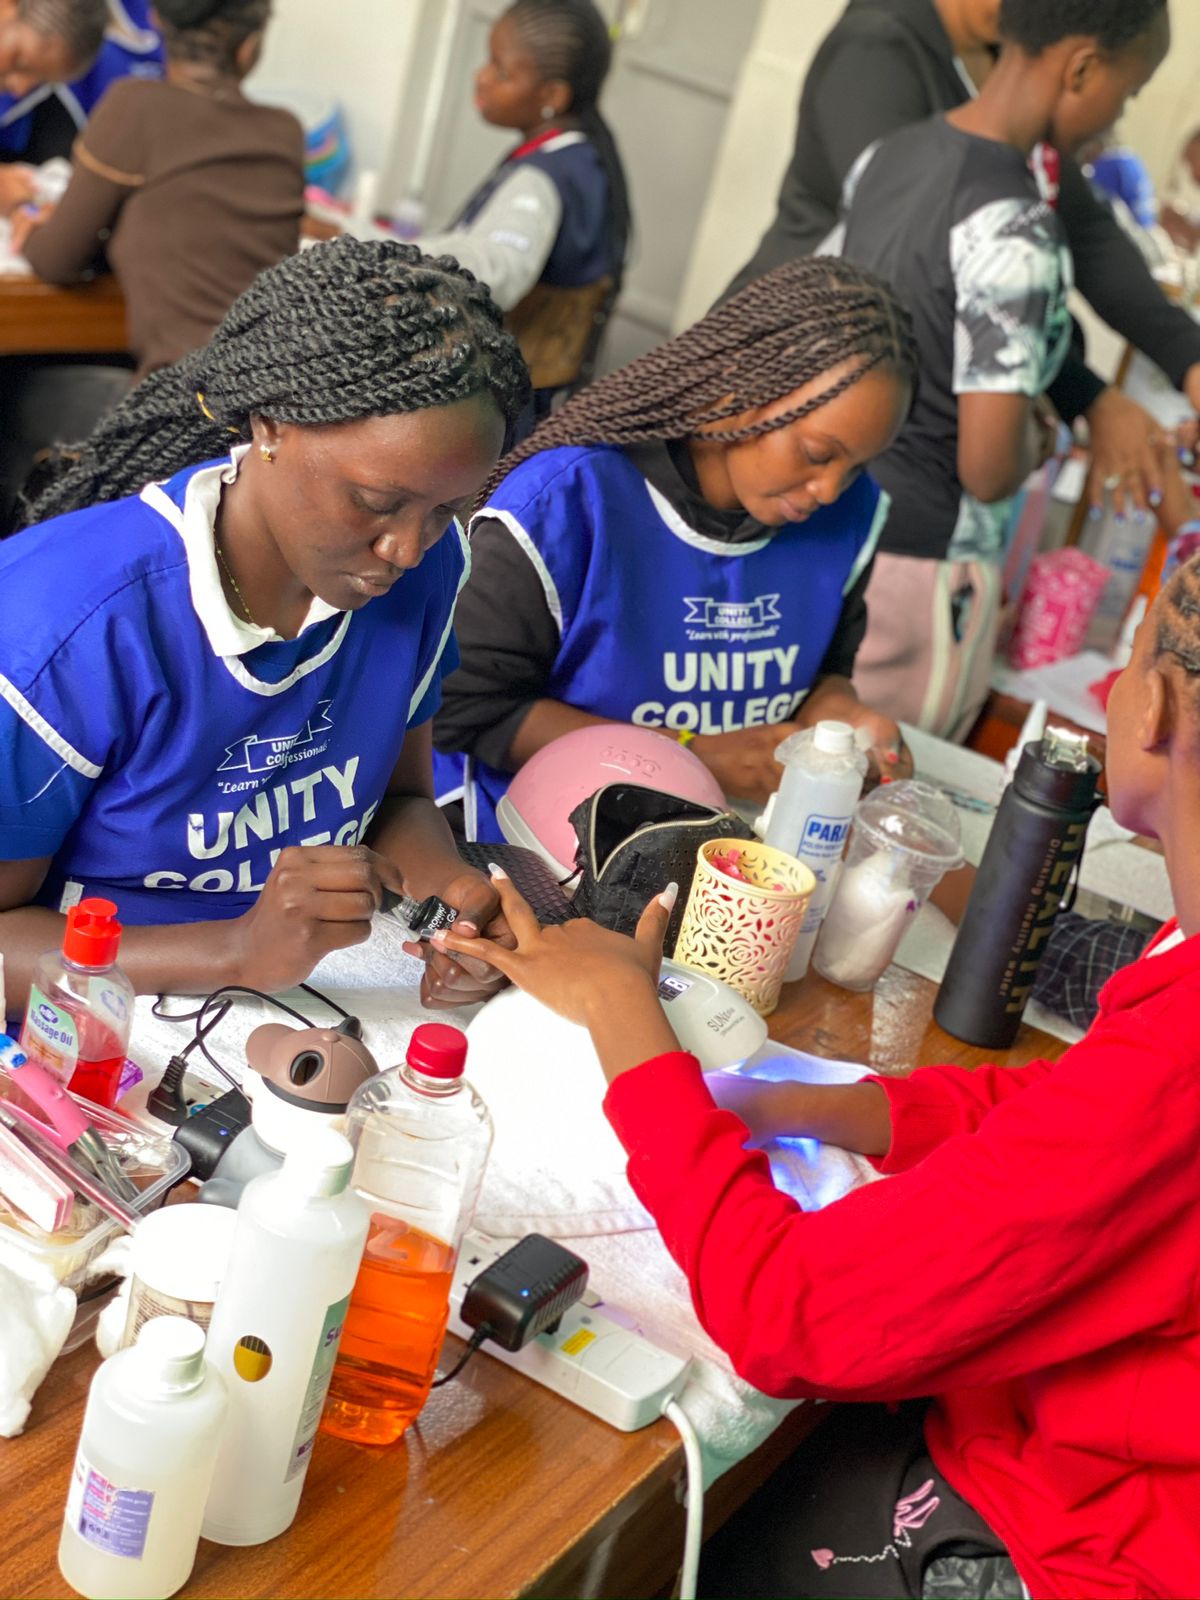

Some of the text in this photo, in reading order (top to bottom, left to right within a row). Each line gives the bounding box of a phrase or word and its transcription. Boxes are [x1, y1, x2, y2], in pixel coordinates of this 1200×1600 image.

[663, 644, 799, 693] UNITY
[187, 756, 360, 860] UNITY
[60, 1034, 73, 1047] Oil
